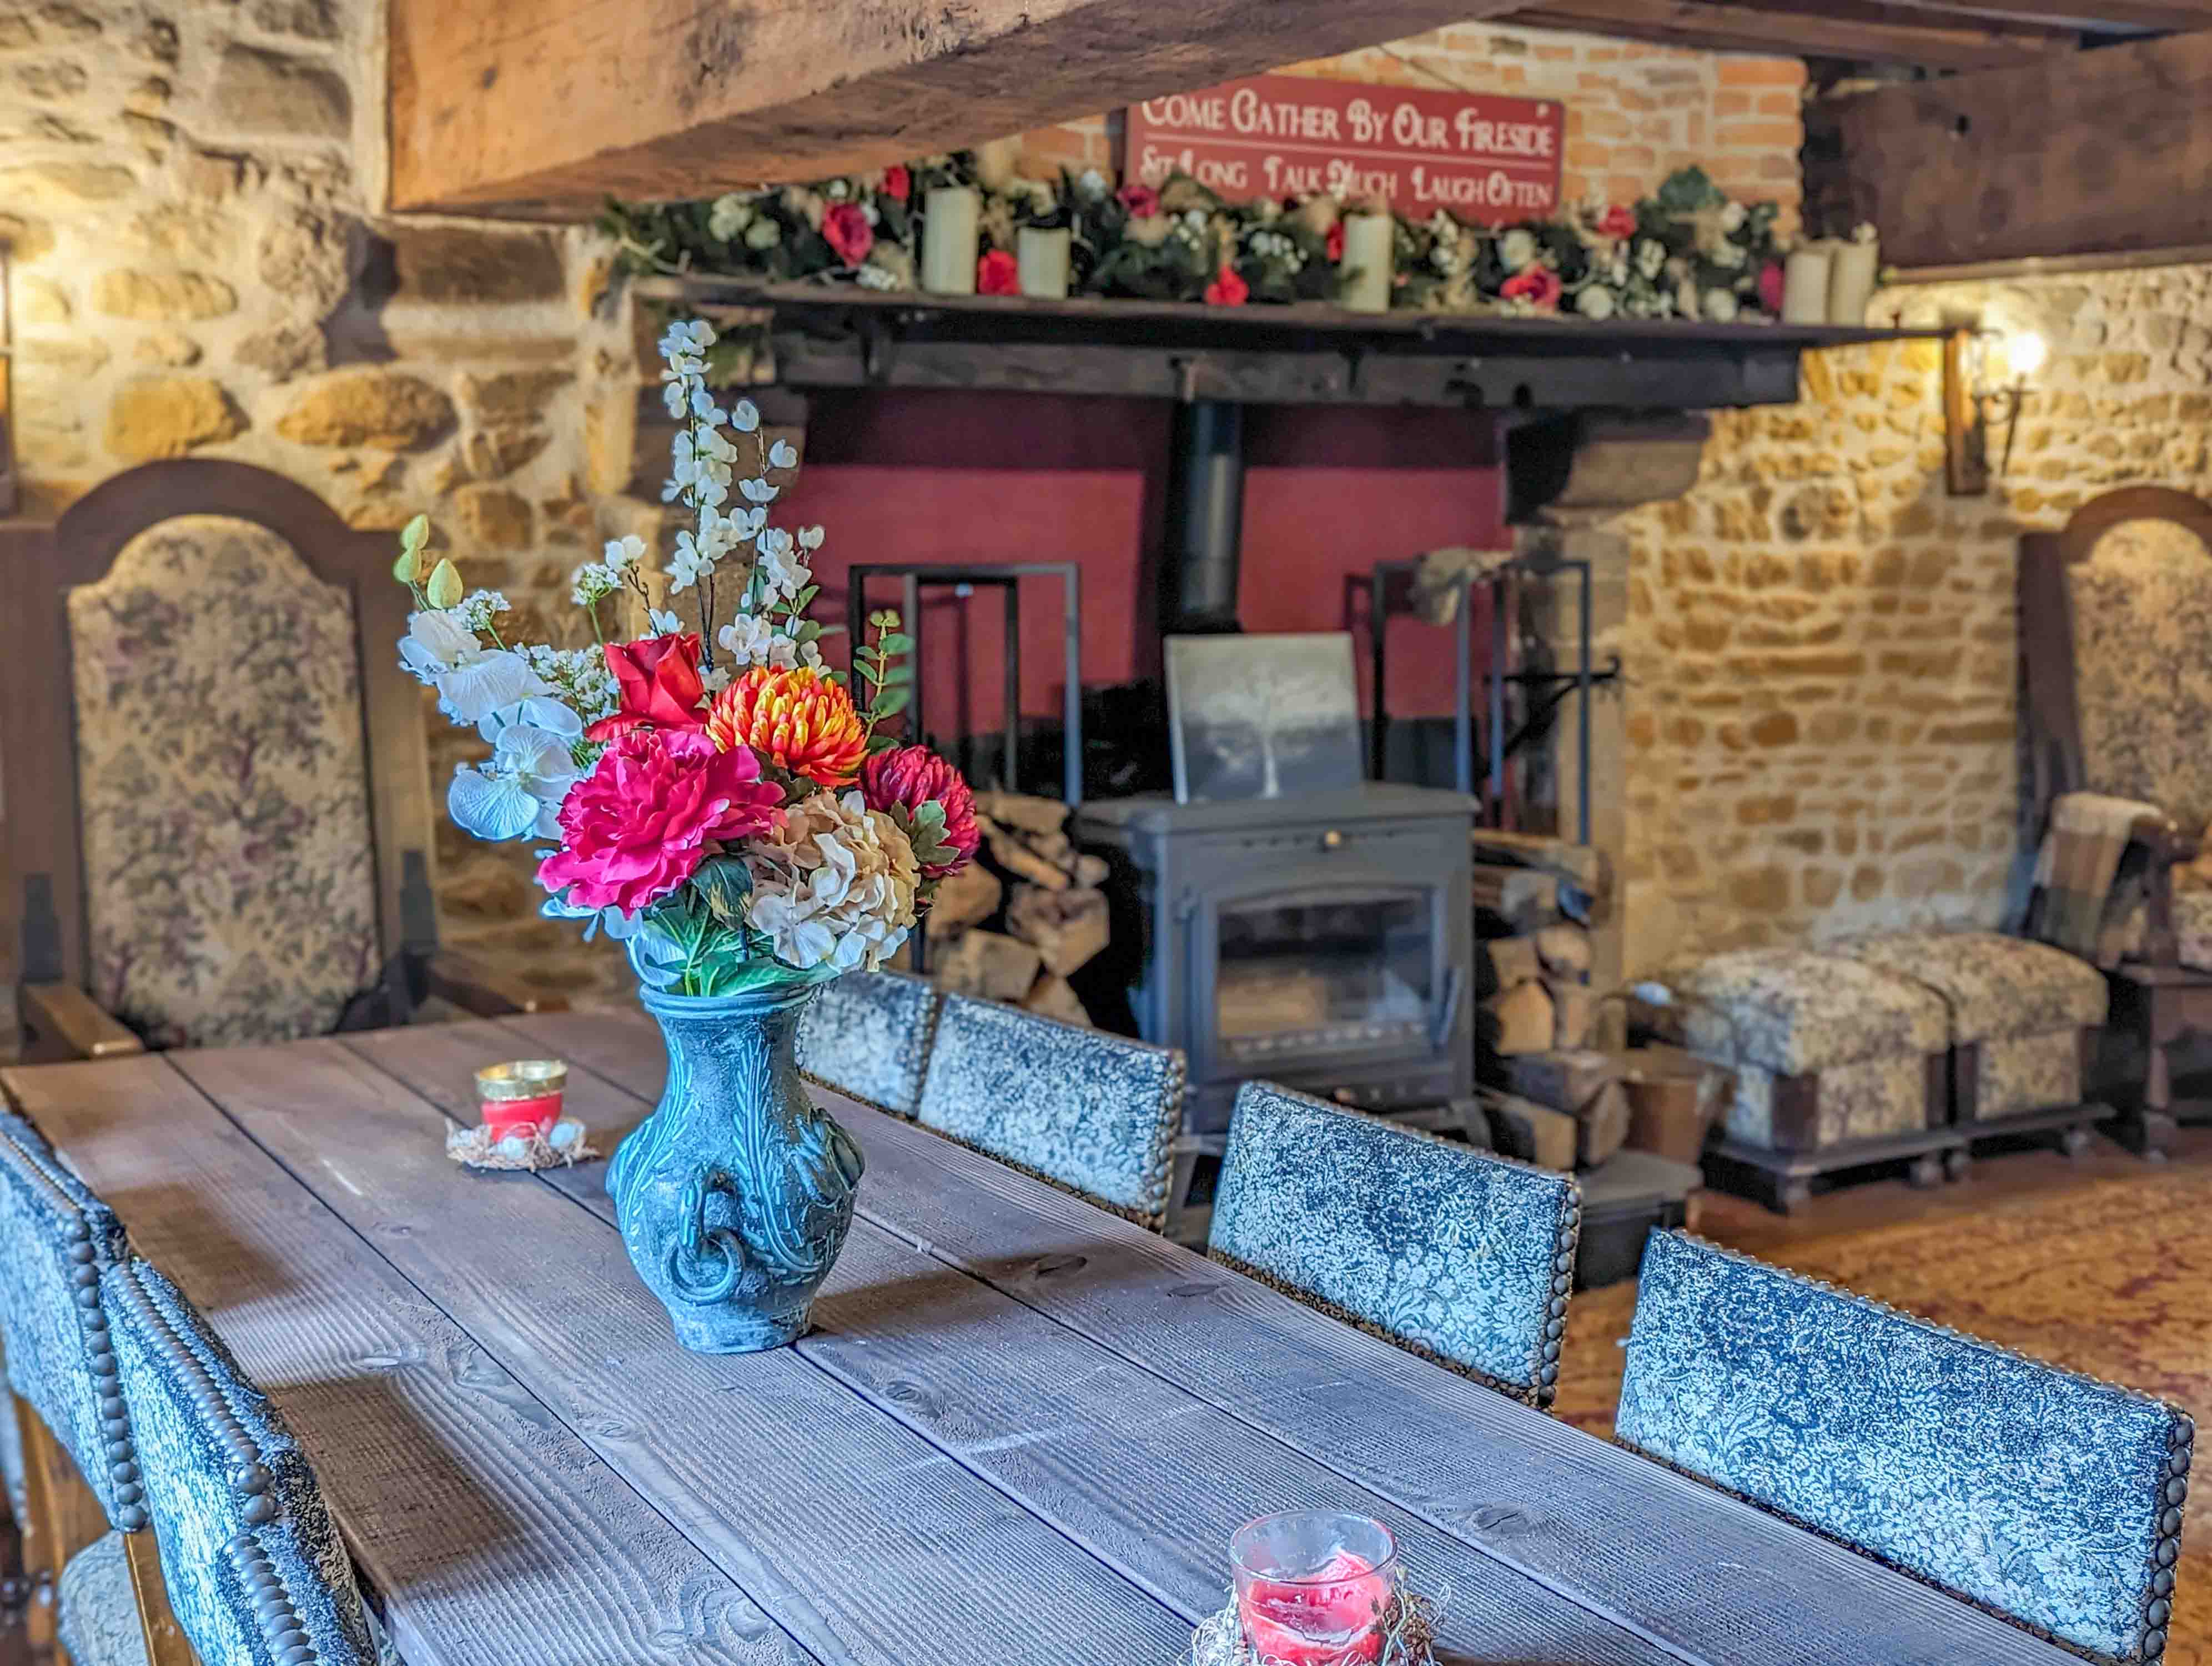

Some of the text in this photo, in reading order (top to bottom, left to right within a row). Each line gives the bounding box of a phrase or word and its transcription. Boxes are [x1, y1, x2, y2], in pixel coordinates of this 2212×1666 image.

[1142, 88, 1554, 157] COME GATHER BY OUR FIRESIDE
[1263, 155, 1323, 194] TALK
[1411, 167, 1485, 204] LAUGH
[1486, 170, 1553, 208] OFTEN
